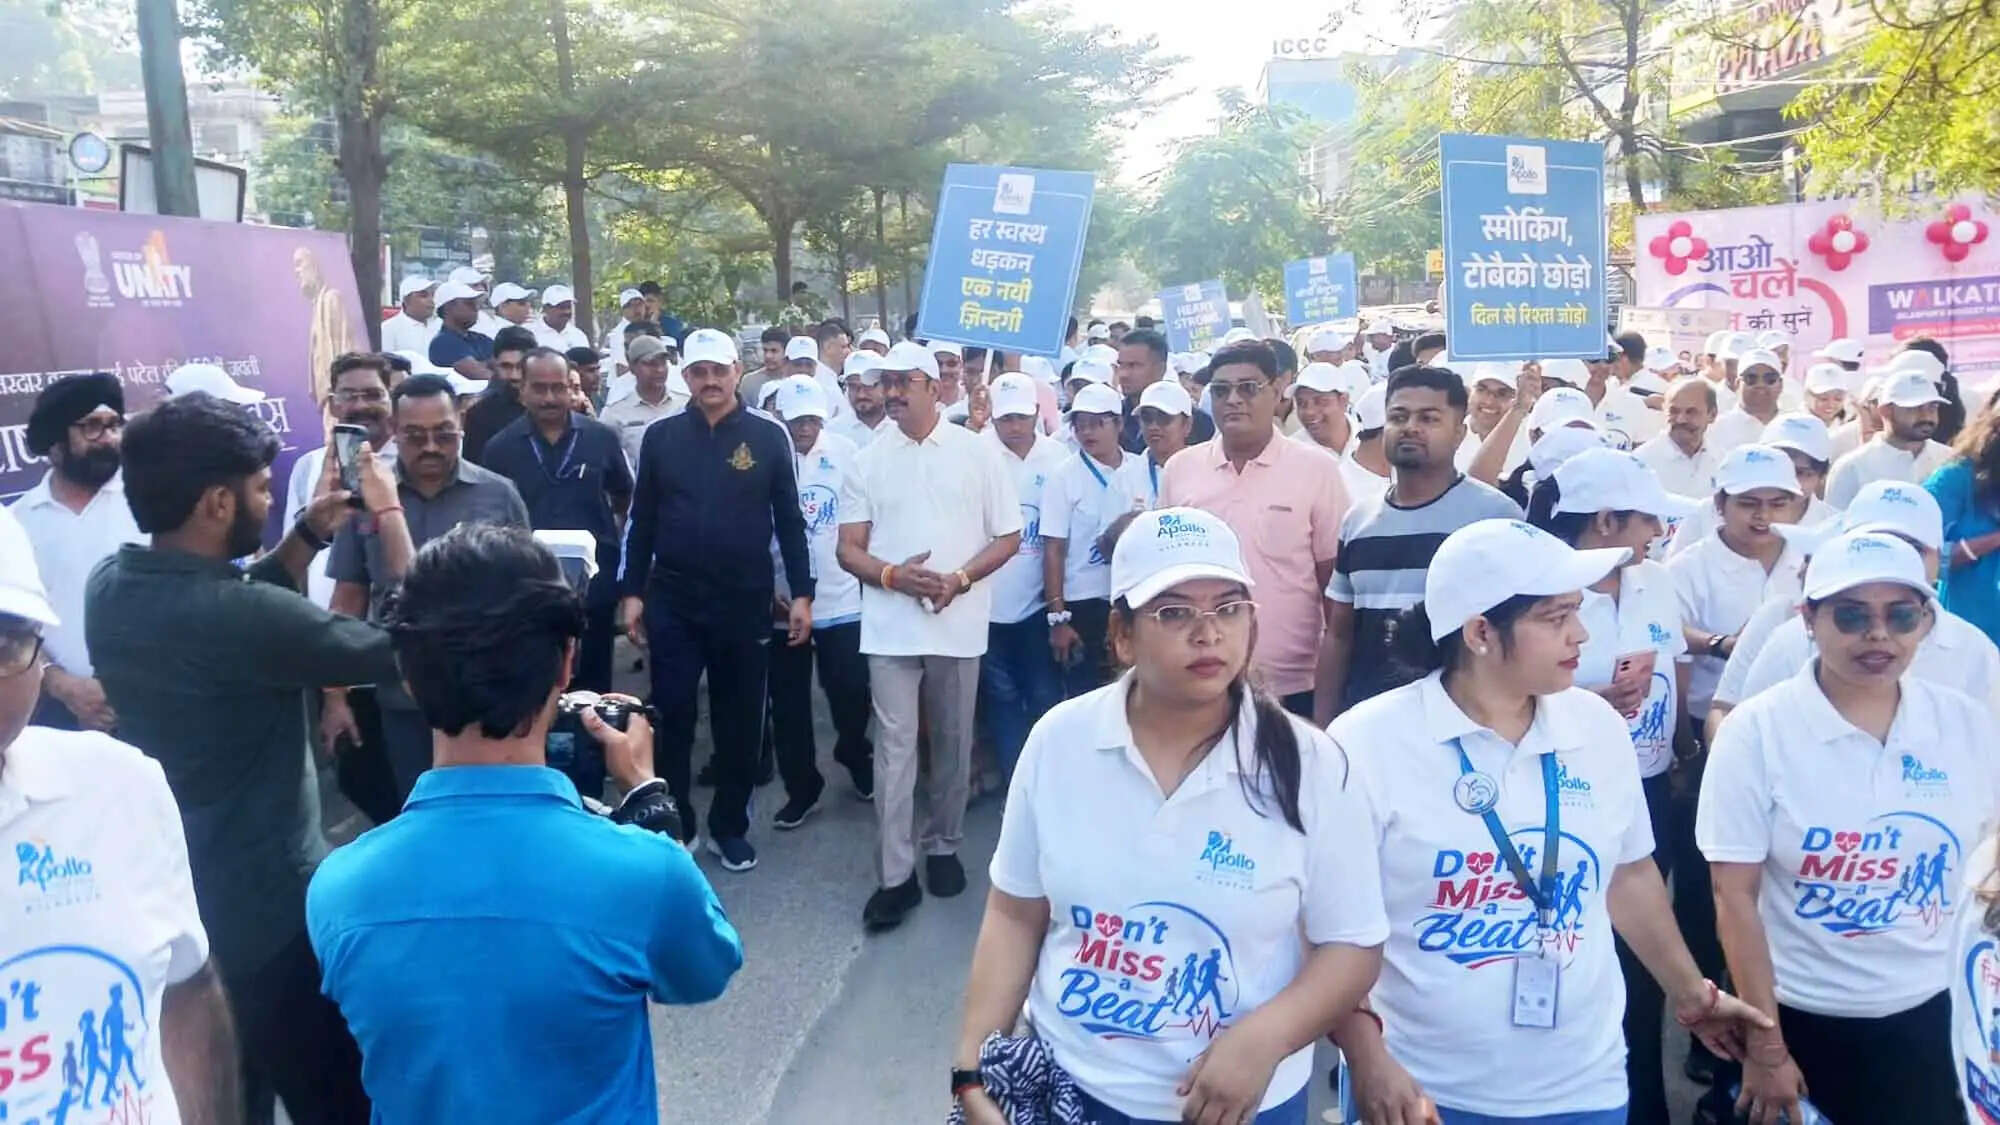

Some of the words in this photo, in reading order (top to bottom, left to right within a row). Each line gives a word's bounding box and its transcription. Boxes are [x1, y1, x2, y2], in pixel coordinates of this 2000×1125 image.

[1272, 37, 1328, 55] ICCC
[969, 218, 995, 241] हर
[995, 221, 1048, 245] स्वस्थ
[1479, 205, 1573, 247] स्मोकिंग,
[970, 249, 1036, 274] धड़कन
[1697, 234, 1774, 273] आओ
[1461, 251, 1540, 289] टोबैको
[1729, 257, 1799, 299] चलें
[961, 276, 995, 298] एक
[996, 277, 1033, 304] नयी
[1887, 282, 2000, 309] WALKAT
[1746, 308, 1775, 330] की
[1157, 523, 1206, 539] Apollo
[1557, 776, 1592, 794] pollo
[1199, 847, 1257, 872] Apollo
[1798, 853, 1900, 882] Miss
[18, 855, 93, 892] Apollo
[1793, 880, 1907, 924] Beat
[1855, 884, 1867, 896] a
[1484, 903, 1498, 915] a
[1413, 911, 1541, 951] Beat
[1074, 931, 1166, 982] Miss
[1119, 978, 1132, 991] a
[1056, 968, 1175, 1033] Beat
